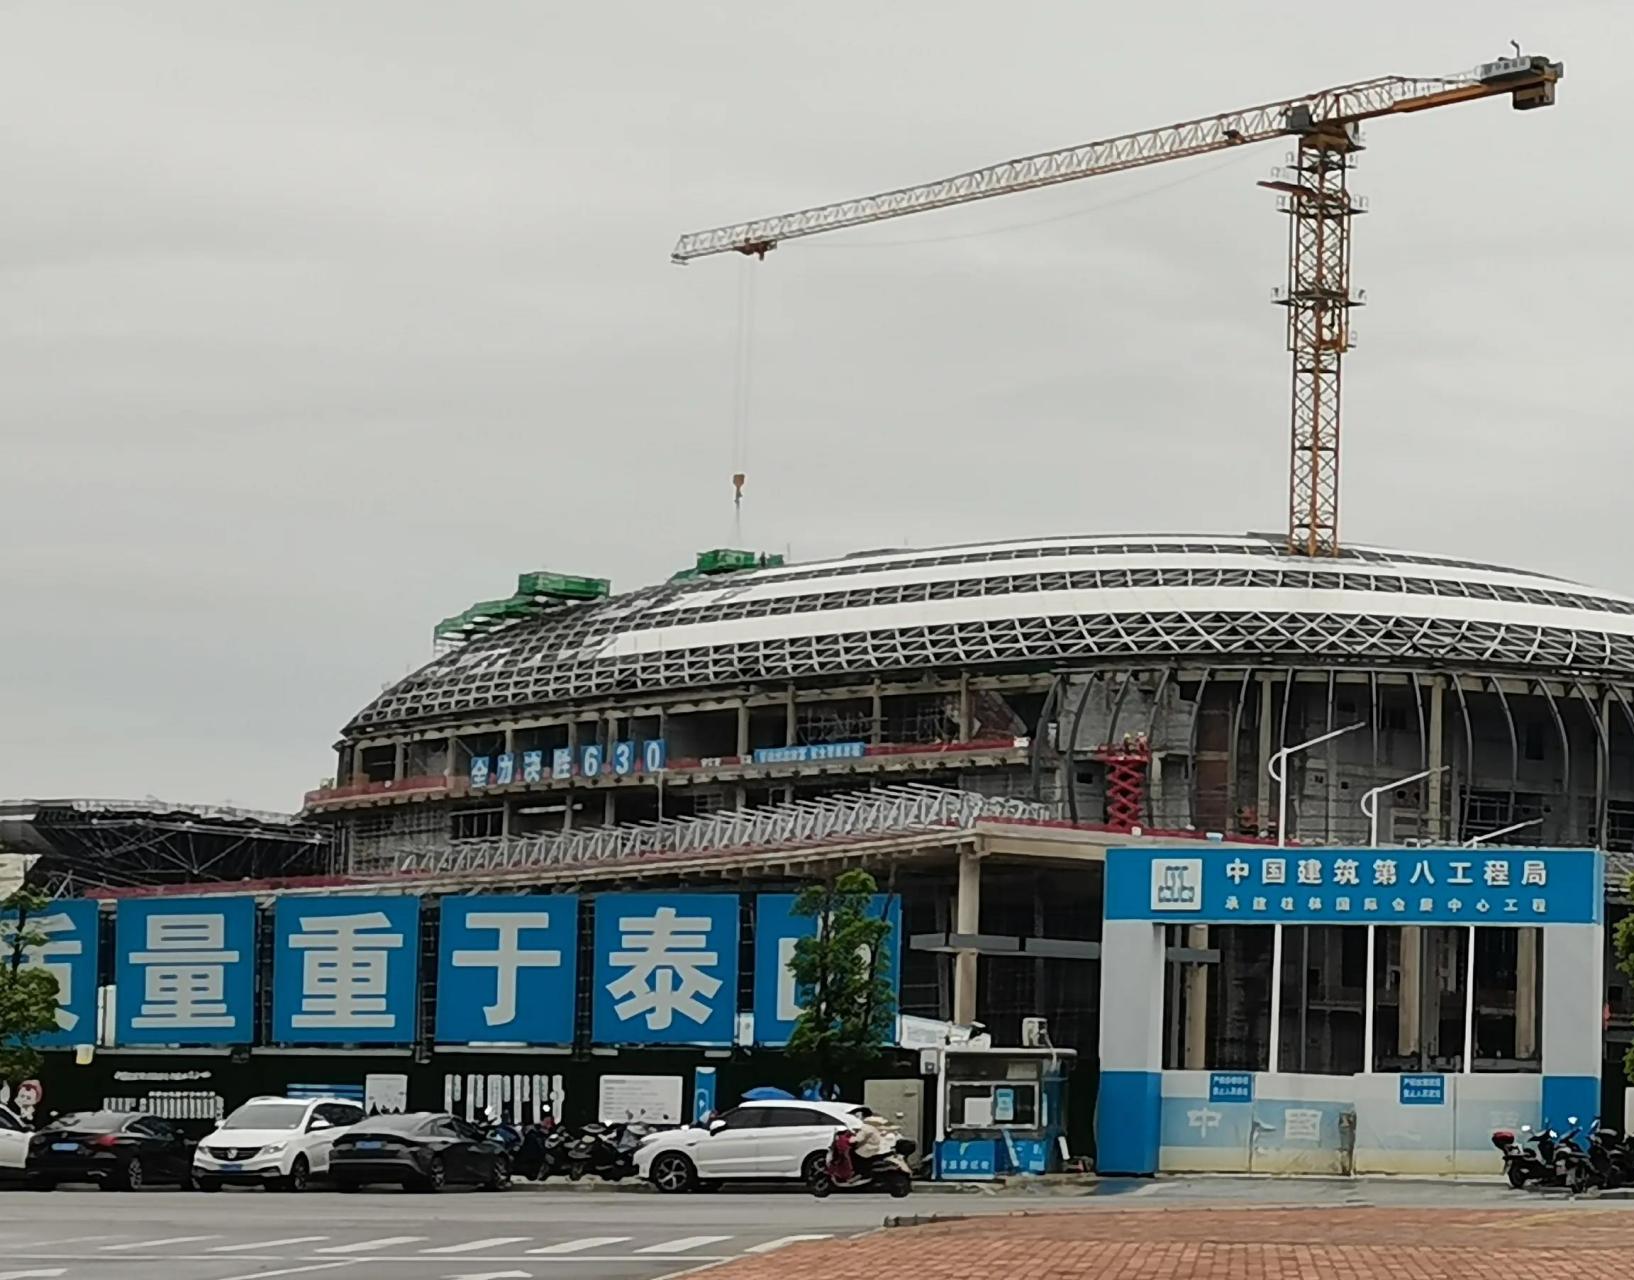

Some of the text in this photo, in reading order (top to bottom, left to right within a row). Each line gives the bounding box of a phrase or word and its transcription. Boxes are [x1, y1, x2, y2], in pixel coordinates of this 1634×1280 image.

[1225, 857, 1547, 886] 中国建筑第八工程局
